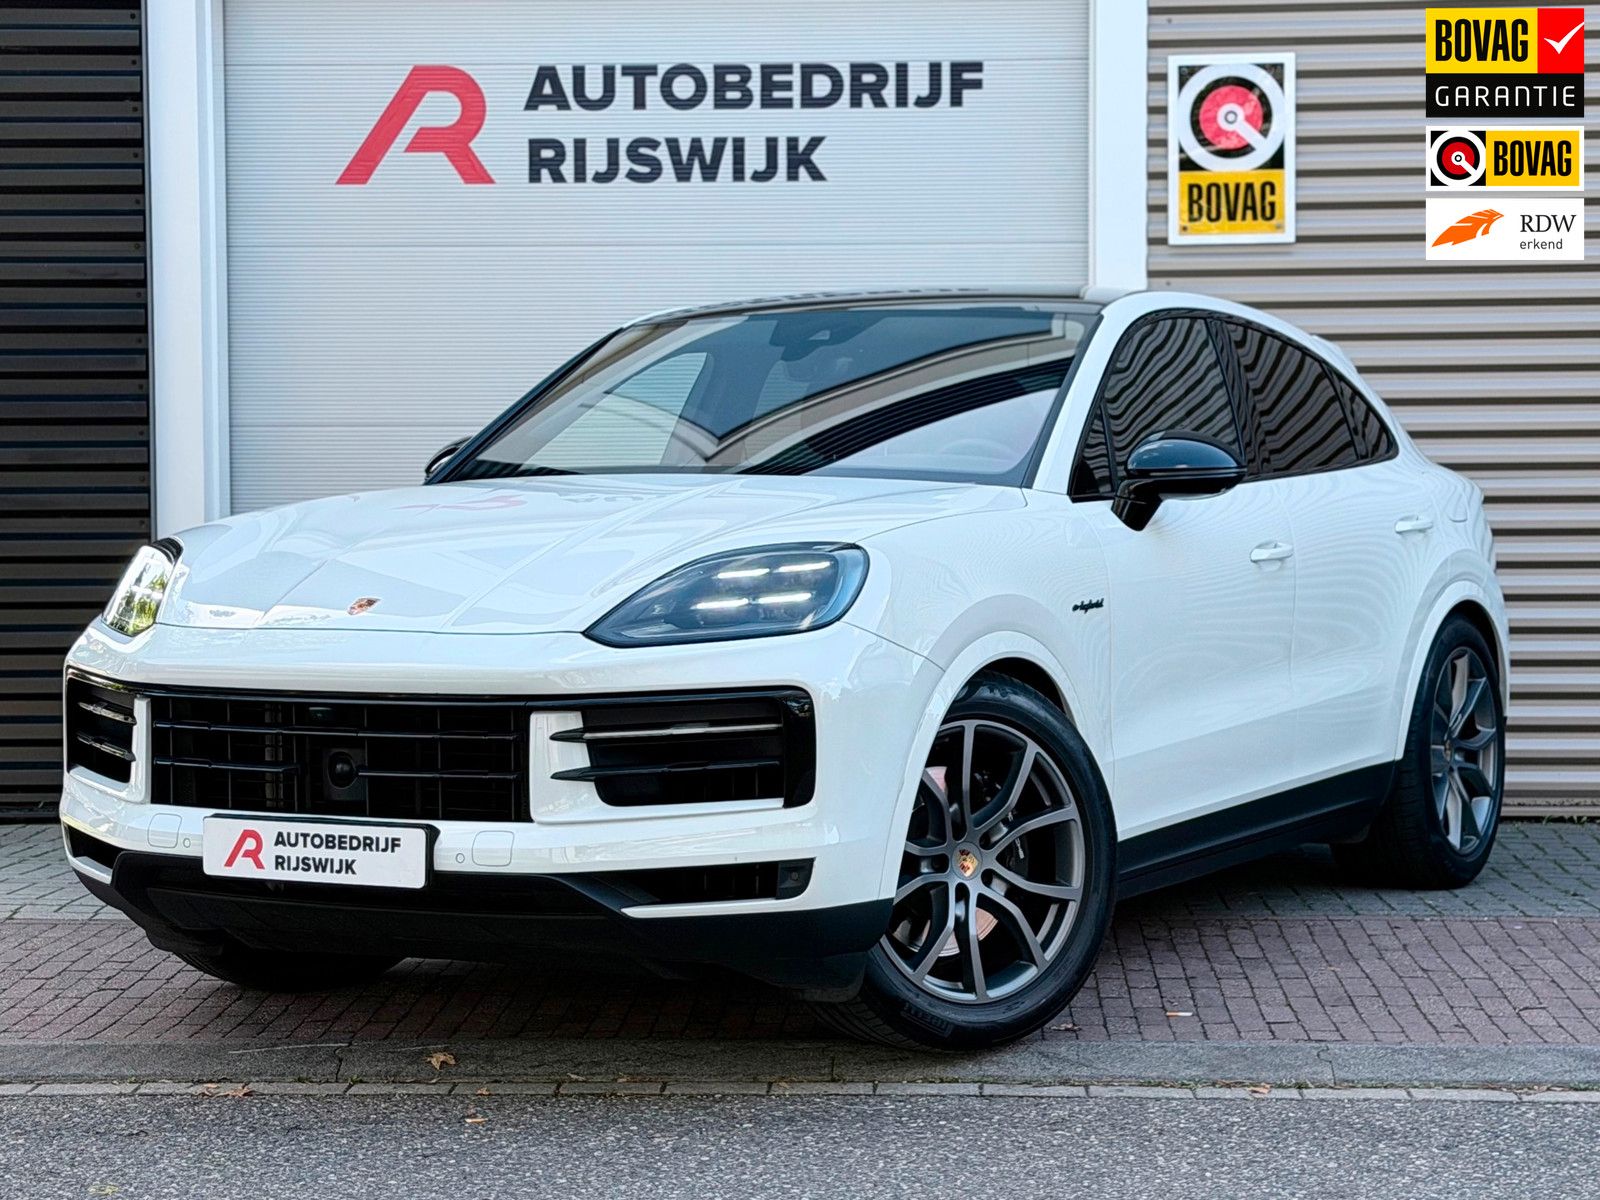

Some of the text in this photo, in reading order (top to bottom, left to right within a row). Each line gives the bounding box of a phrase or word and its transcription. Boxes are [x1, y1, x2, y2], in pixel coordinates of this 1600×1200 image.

[523, 61, 984, 111] AUTOBEDRIJF
[527, 135, 828, 184] RIJSWIJK
[1187, 181, 1276, 223] BOVAG
[273, 831, 402, 854] AUTOBEDRIJF
[274, 855, 358, 876] RIJSWIJK
